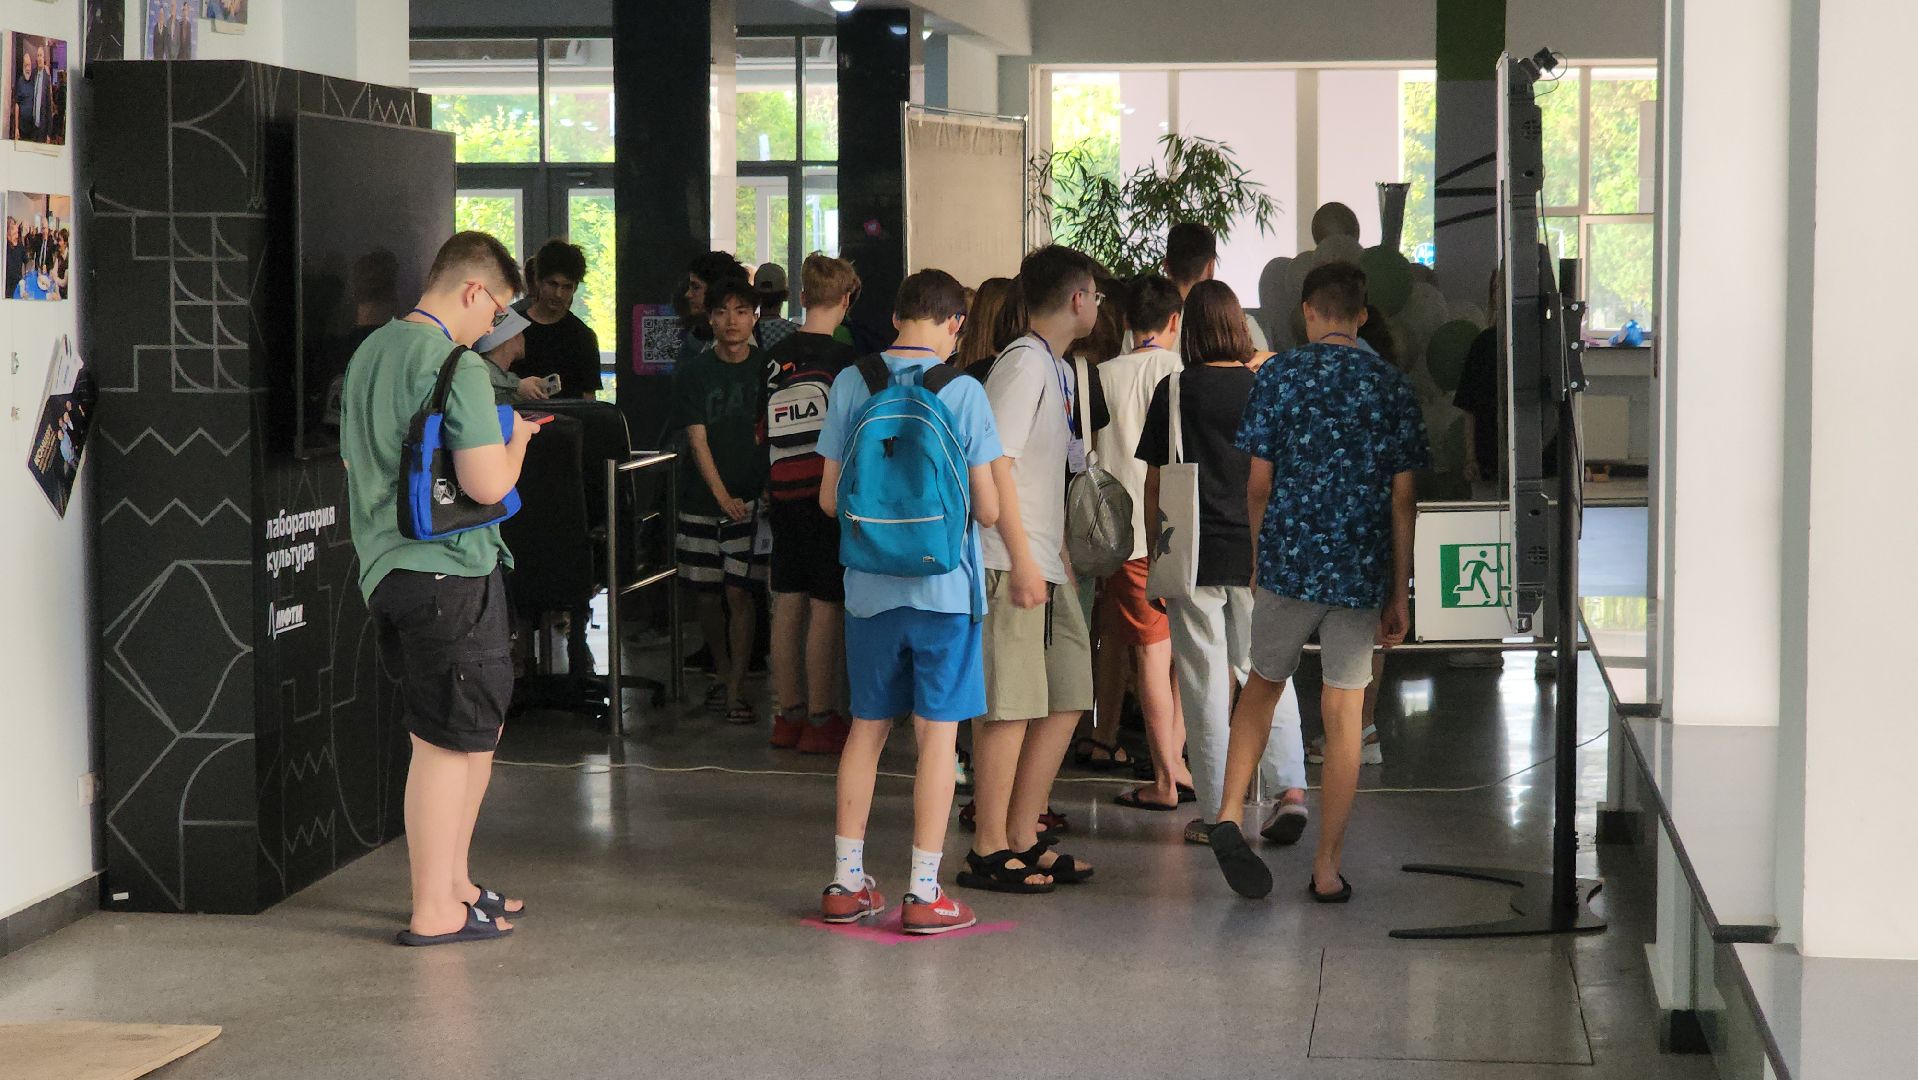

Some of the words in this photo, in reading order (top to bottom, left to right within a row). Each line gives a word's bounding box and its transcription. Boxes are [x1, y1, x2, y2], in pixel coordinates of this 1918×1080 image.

[774, 401, 819, 423] FILA
[266, 505, 336, 541] лаборатория
[266, 542, 315, 579] культура
